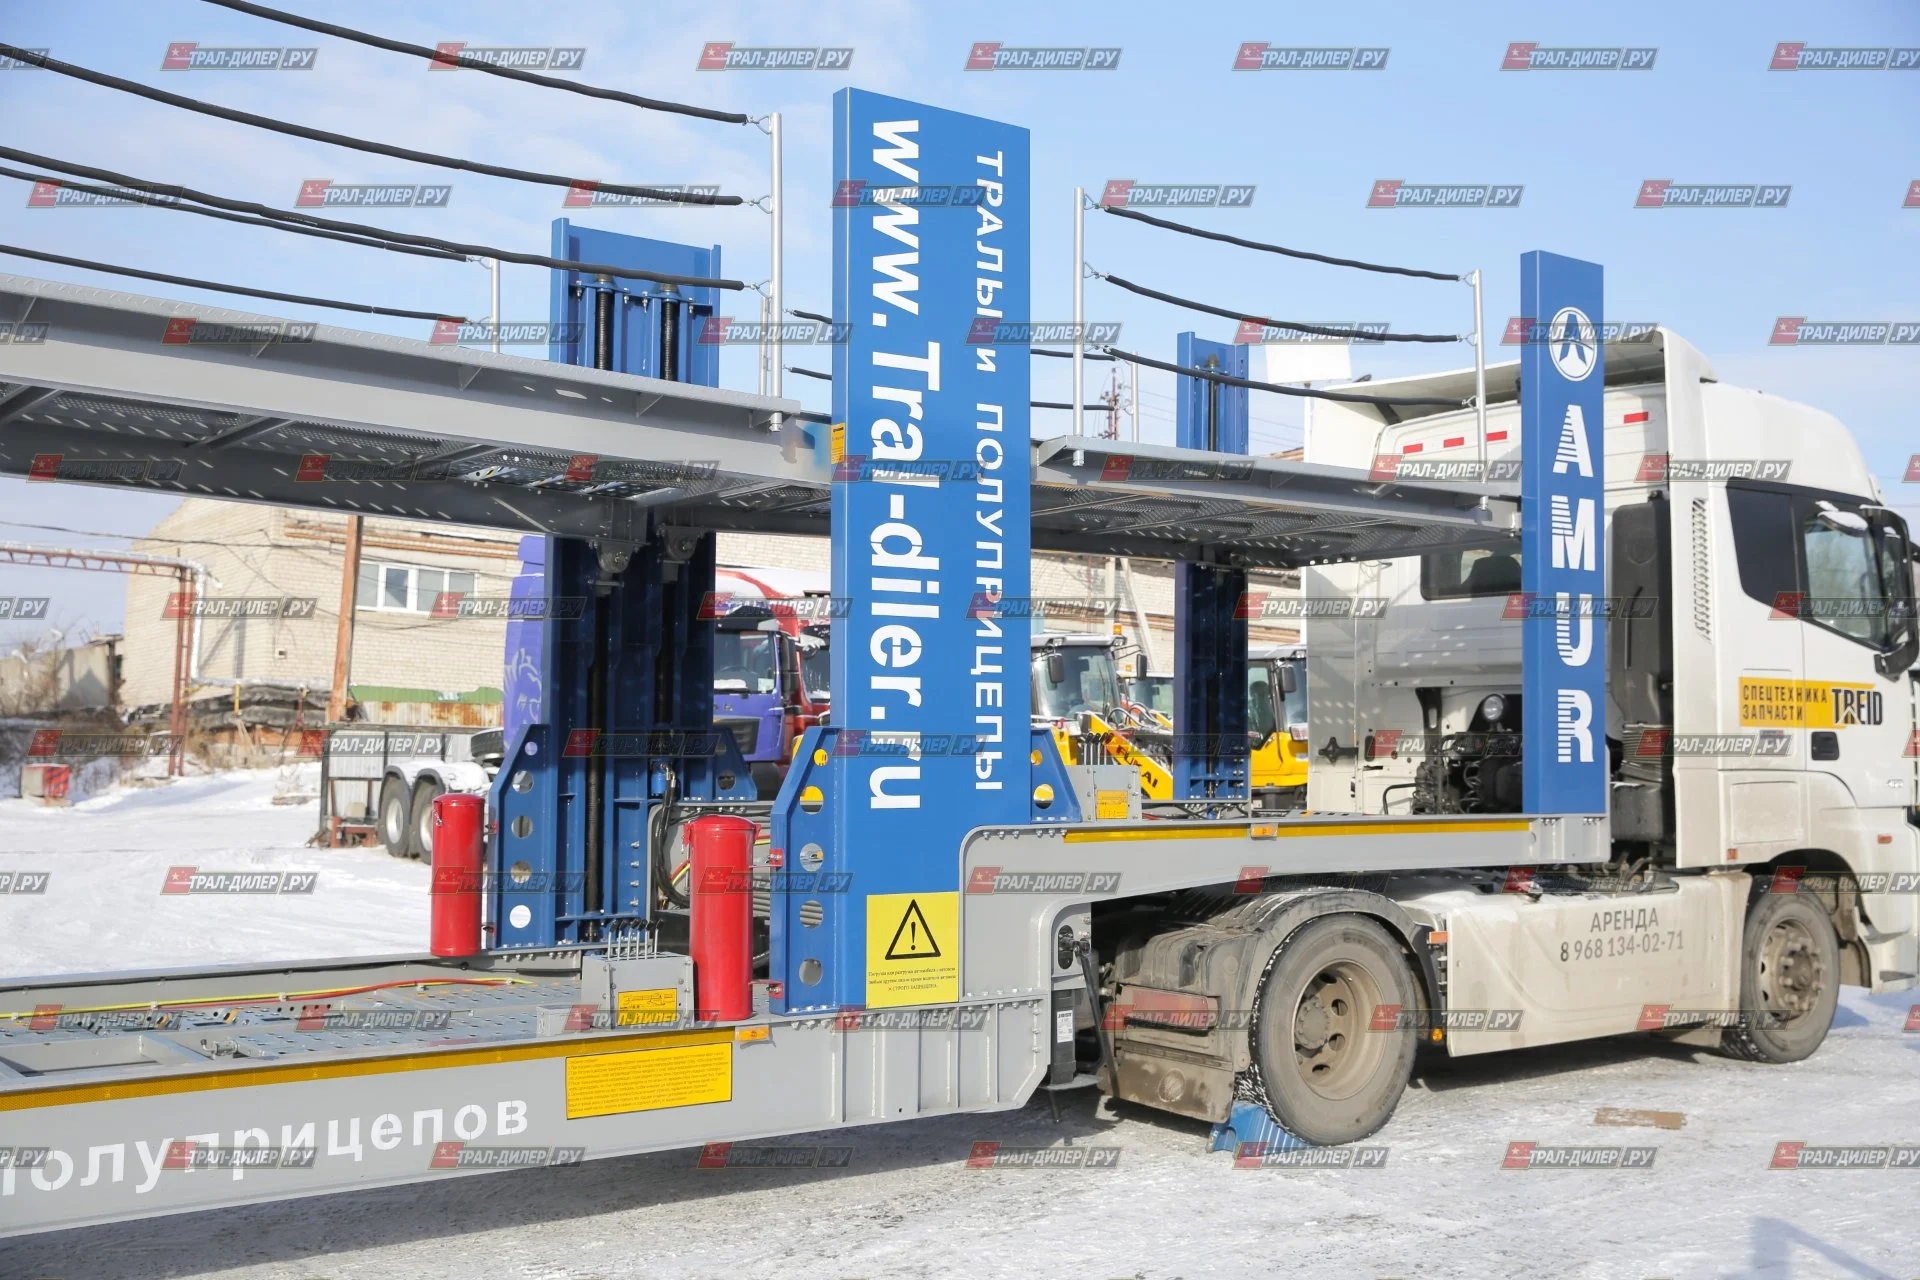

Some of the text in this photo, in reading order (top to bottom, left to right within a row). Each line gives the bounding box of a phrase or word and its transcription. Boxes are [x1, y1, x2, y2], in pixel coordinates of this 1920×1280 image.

[976, 151, 1003, 319] ТРАЛЫ
[871, 120, 940, 809] www.Tral-diler.ru
[970, 402, 1003, 790] ПОЛУПРИЦЕПЫ
[1551, 403, 1597, 764] AMUR
[1742, 684, 1828, 703] СПЕЦТЕХНИКА
[1742, 704, 1804, 721] ЗАПЧАСТИ
[1831, 688, 1883, 726] TREID
[1590, 907, 1660, 933] АРЕНДА
[1560, 930, 1684, 962] 8 968 134-02-71
